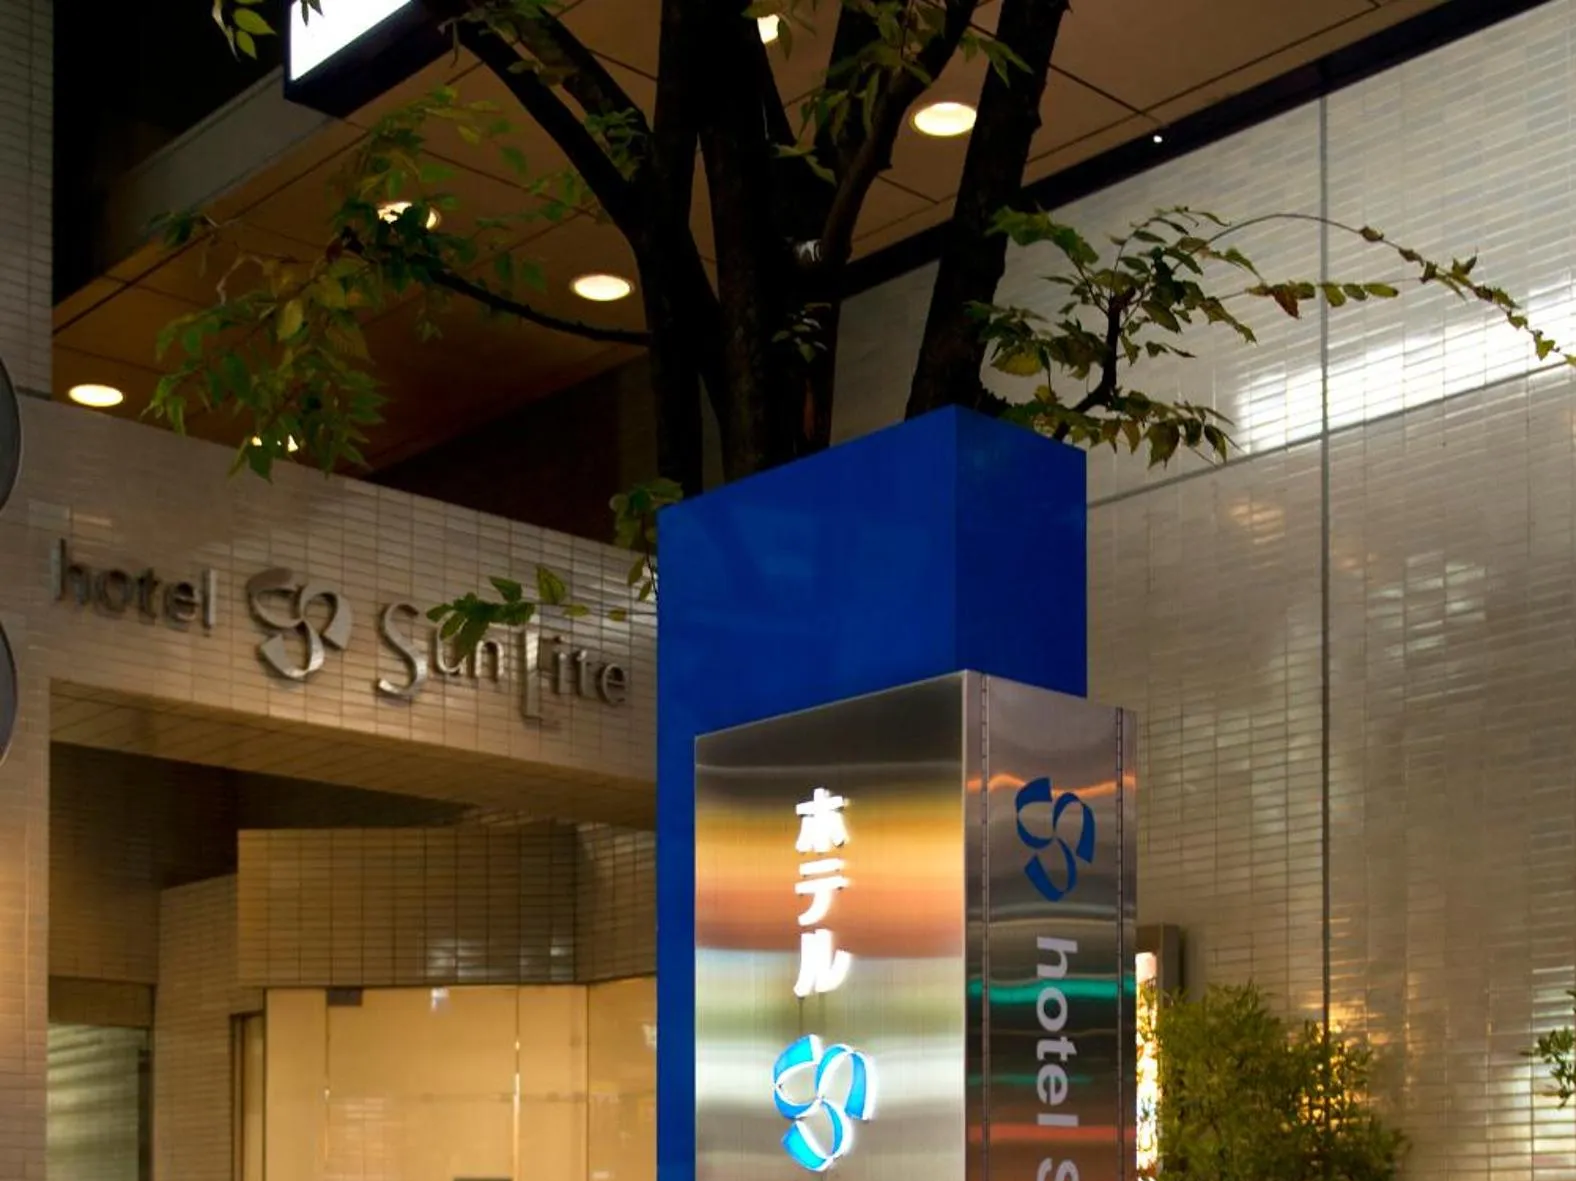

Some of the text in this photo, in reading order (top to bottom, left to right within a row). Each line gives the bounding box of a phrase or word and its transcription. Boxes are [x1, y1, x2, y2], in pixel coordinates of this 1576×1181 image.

[51, 538, 218, 636] hotel
[794, 787, 853, 998] ホテル
[1036, 936, 1079, 1128] hotel
